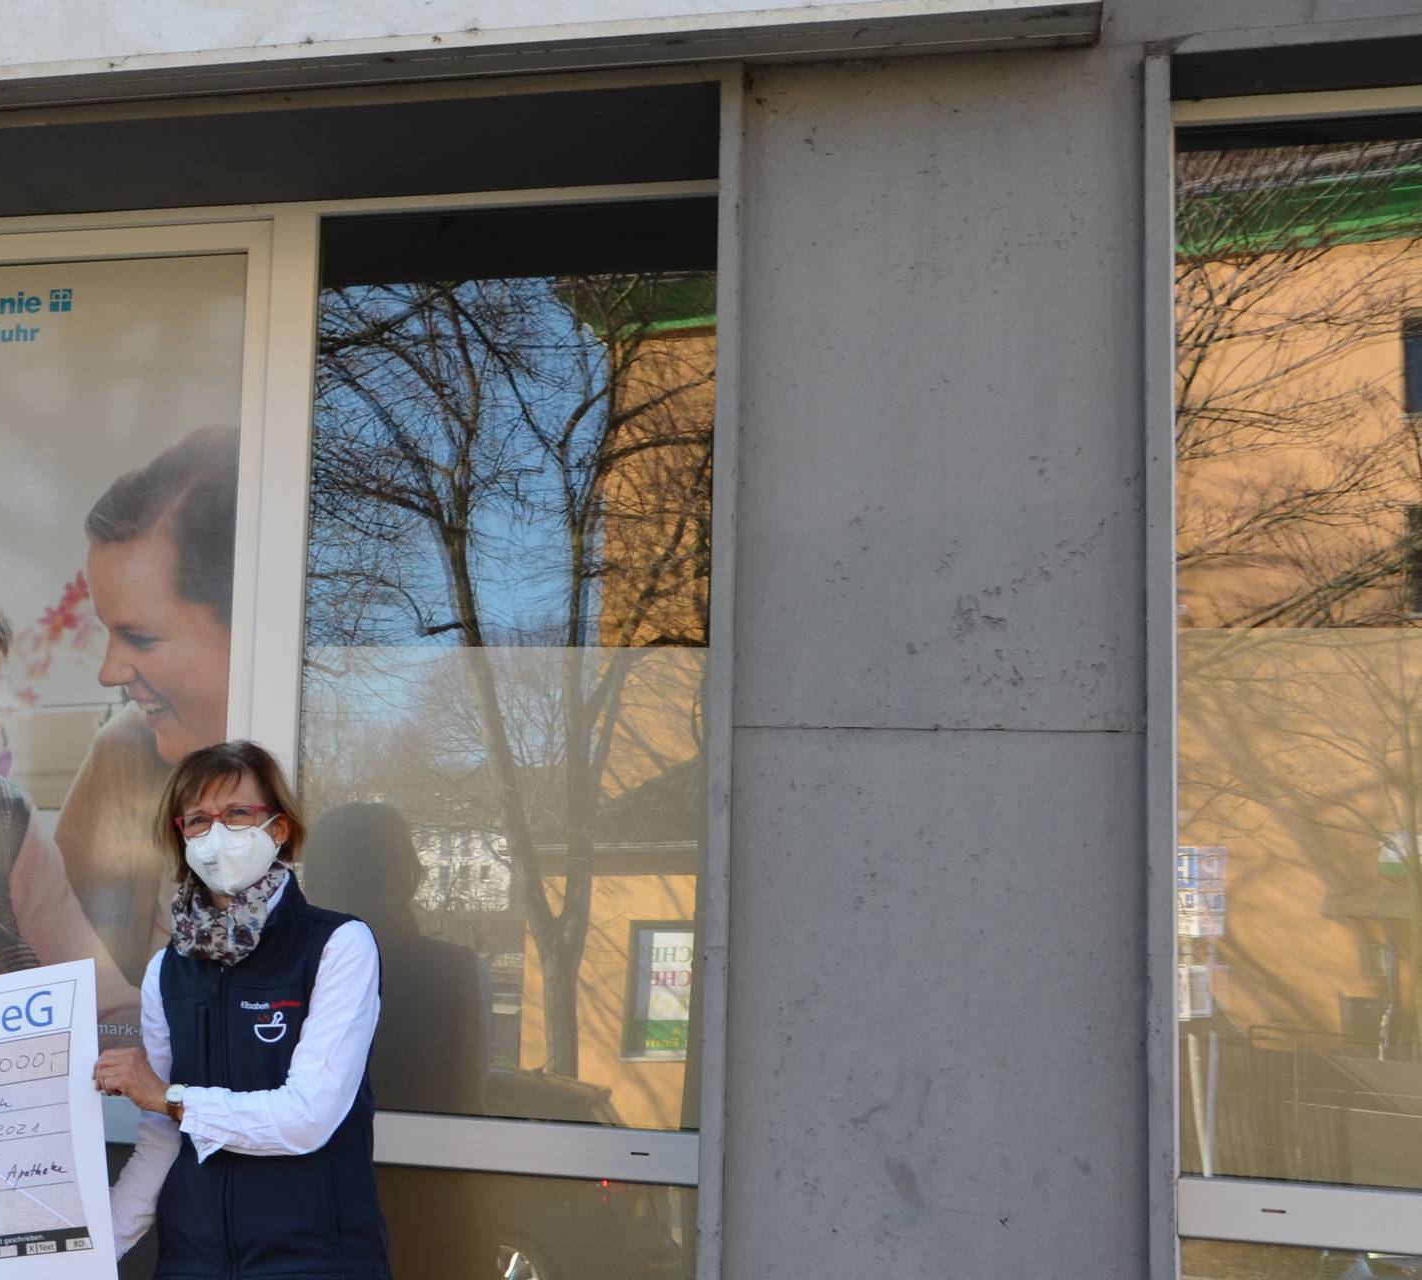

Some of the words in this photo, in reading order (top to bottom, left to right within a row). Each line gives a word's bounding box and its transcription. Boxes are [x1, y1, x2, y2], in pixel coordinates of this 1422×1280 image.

[1, 990, 53, 1032] eG
[5, 1161, 69, 1188] Apotheke
[3, 1235, 45, 1246] geschrieben.
